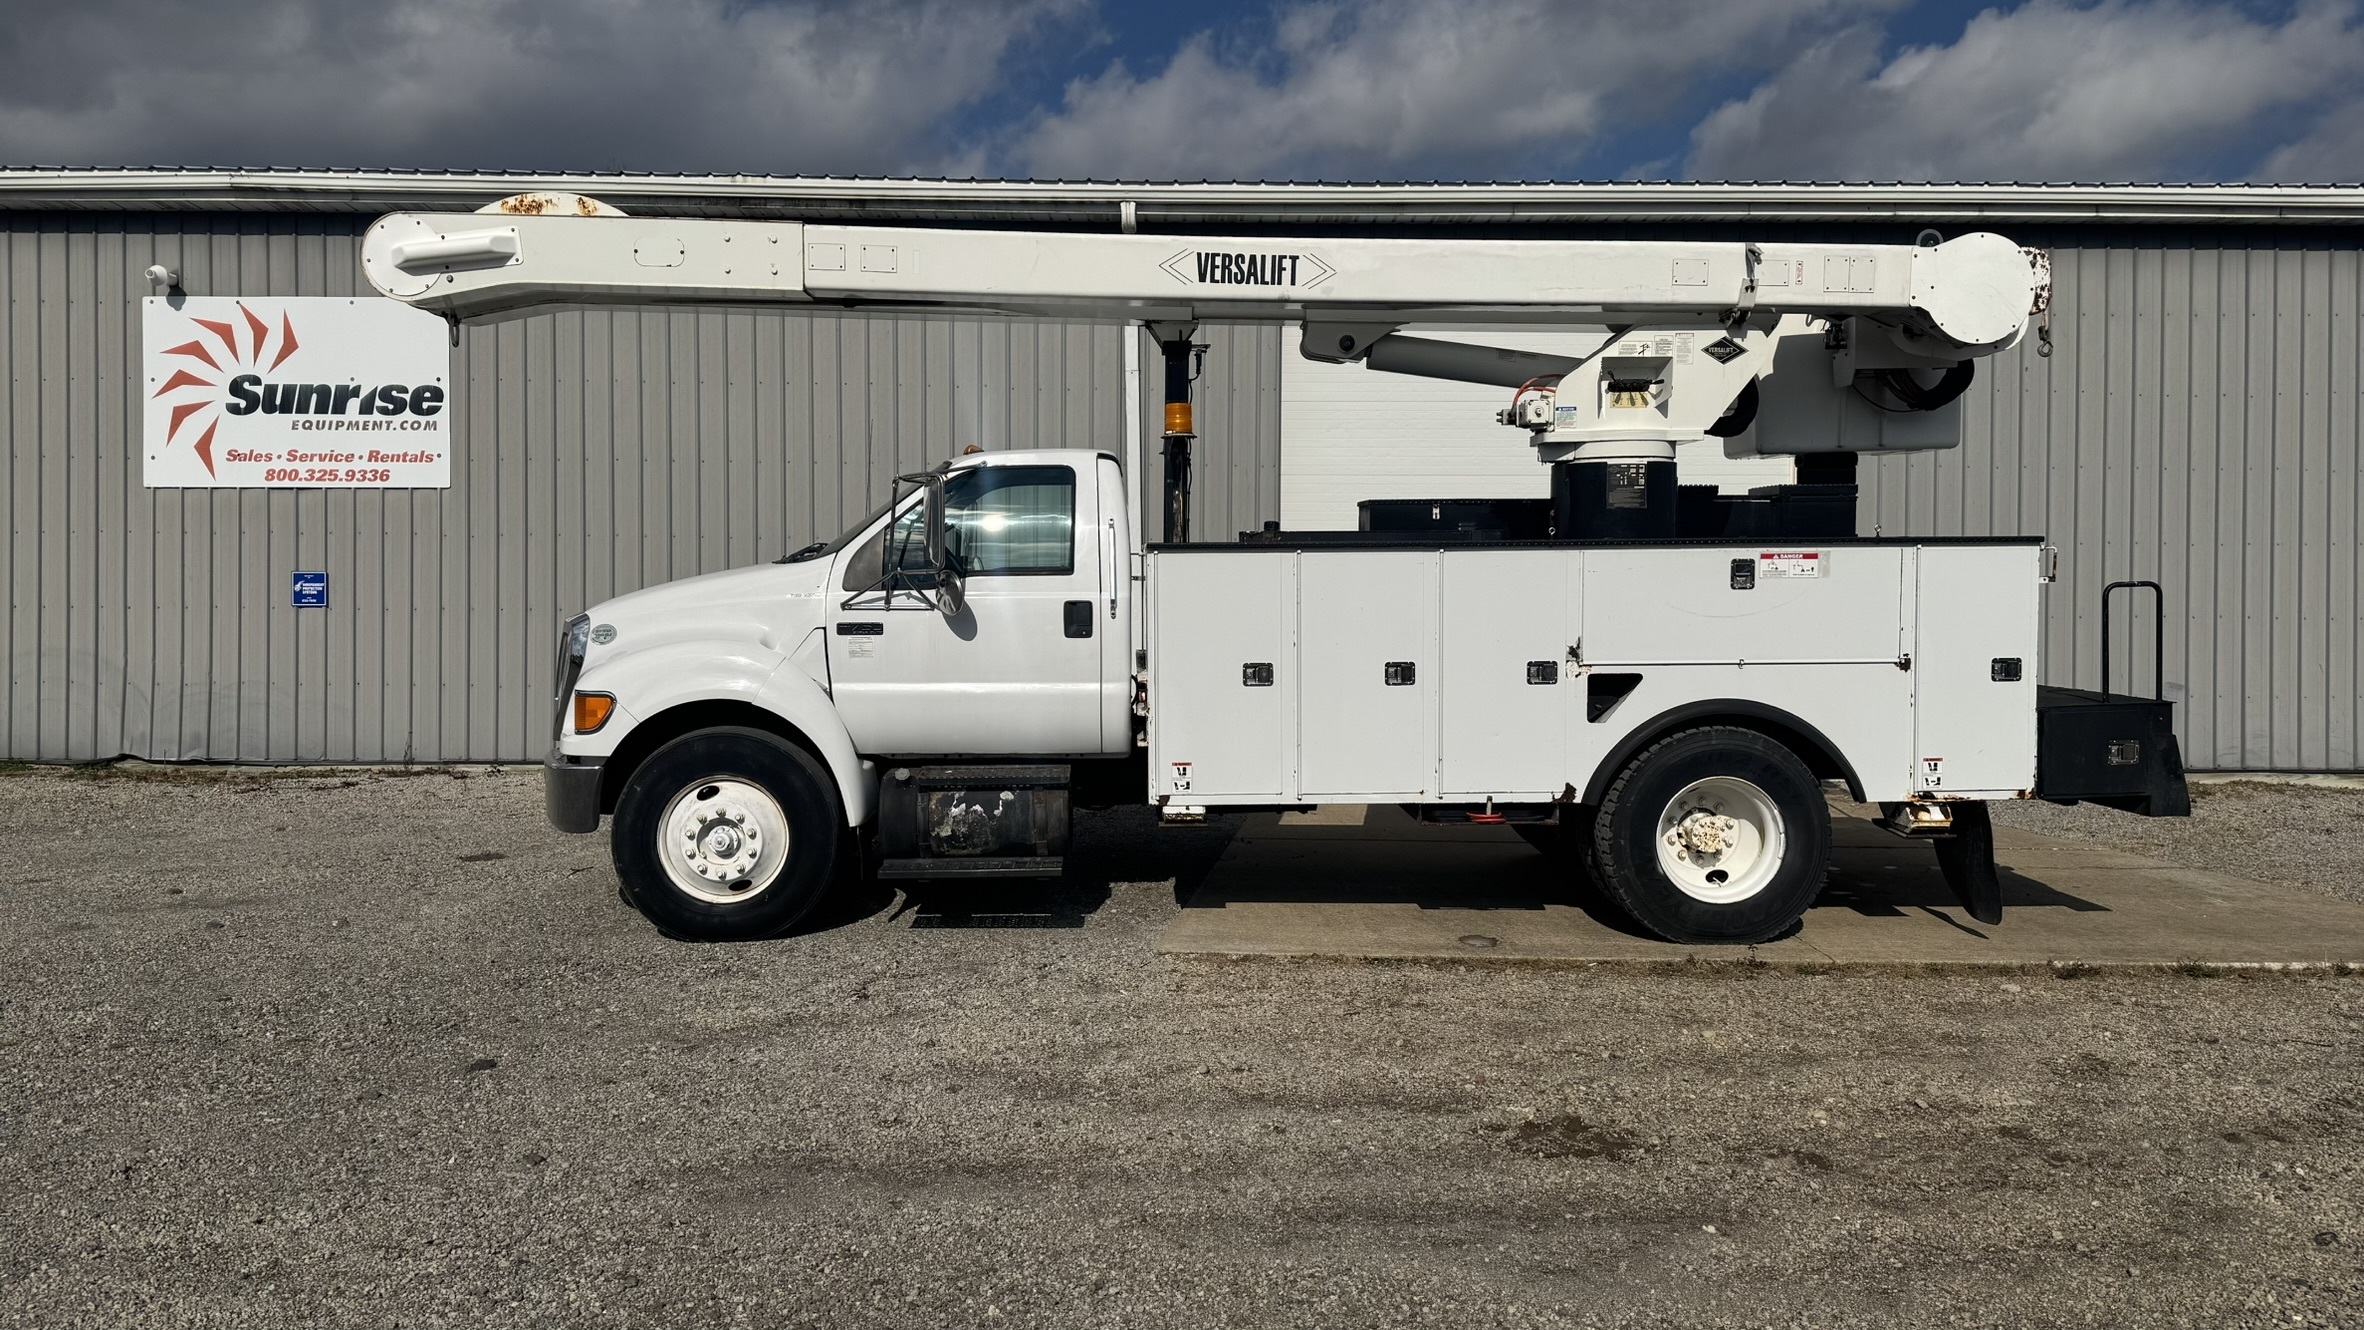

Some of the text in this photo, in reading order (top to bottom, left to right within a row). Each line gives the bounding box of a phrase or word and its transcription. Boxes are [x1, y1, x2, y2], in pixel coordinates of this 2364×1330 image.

[1196, 251, 1300, 287] VERSALIFT
[225, 373, 445, 417] Sunrise
[291, 419, 438, 431] EQUIPMENT.COM
[226, 448, 434, 463] Sales Service Rentals
[264, 468, 391, 482] 800.325.9336
